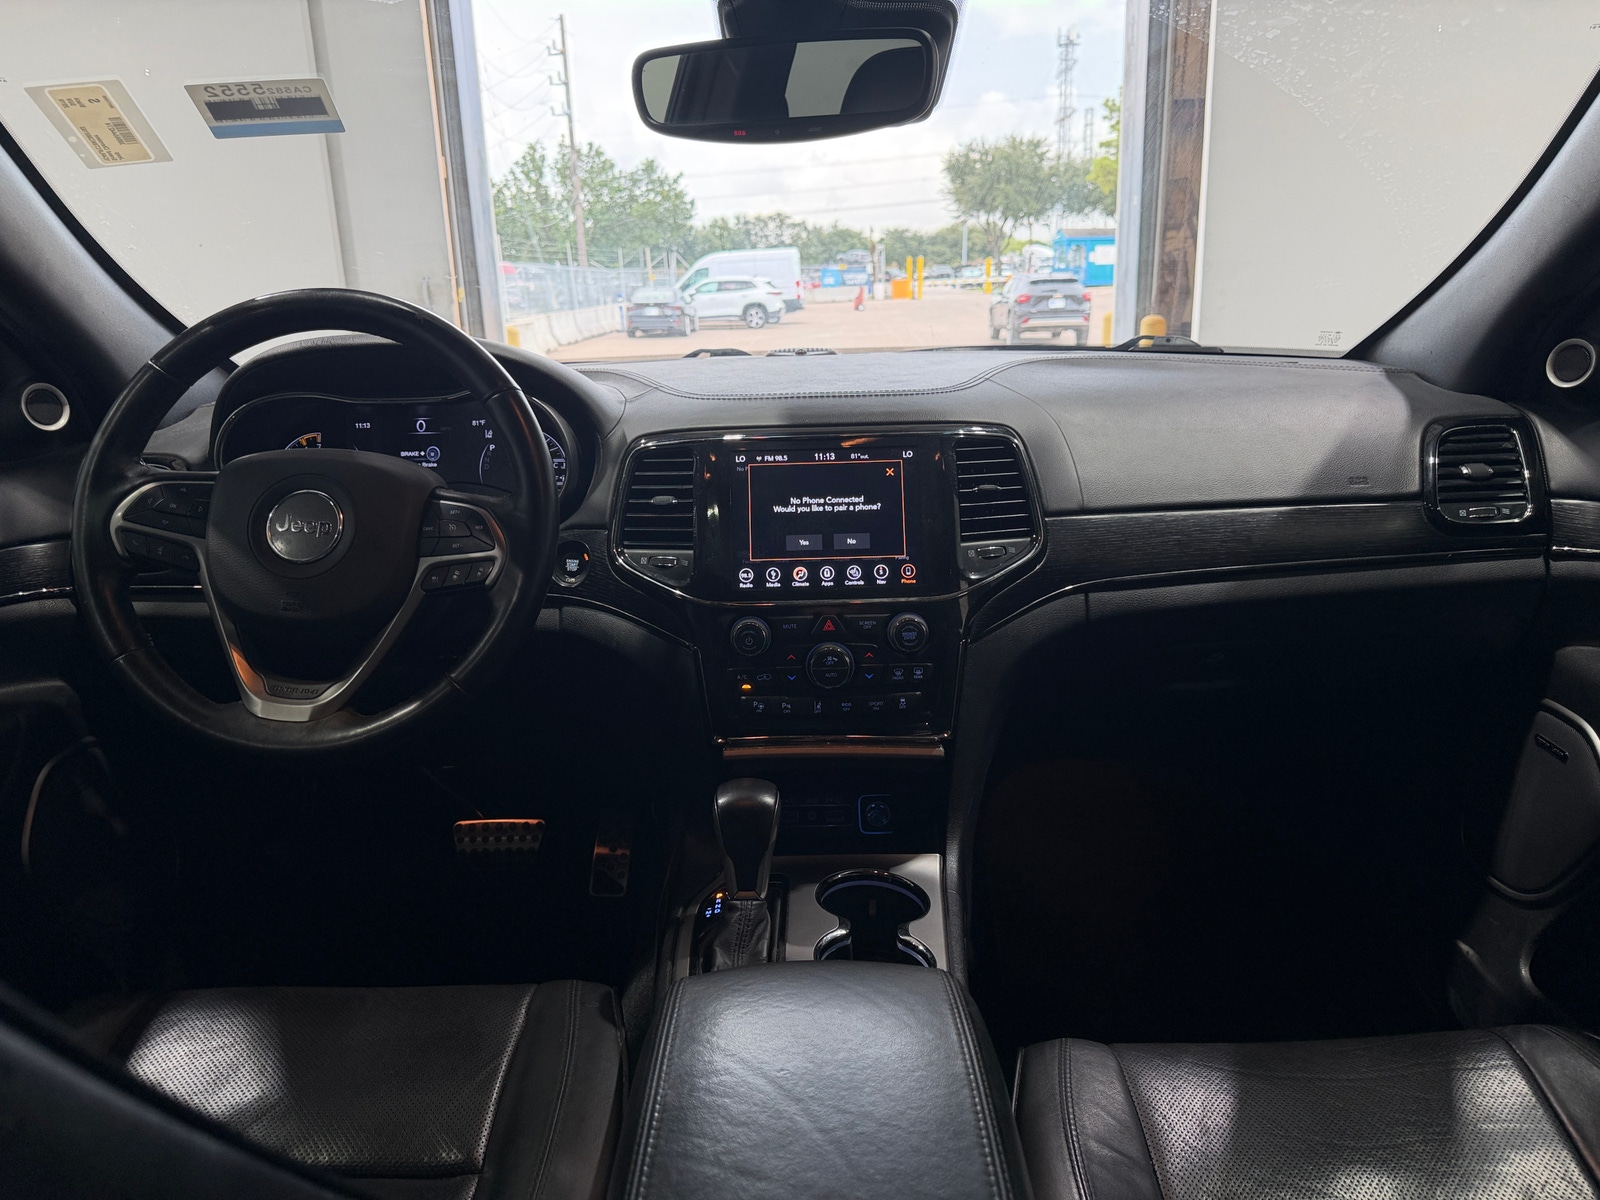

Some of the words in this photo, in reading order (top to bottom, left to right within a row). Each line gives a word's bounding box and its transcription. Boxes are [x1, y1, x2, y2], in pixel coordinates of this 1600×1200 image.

[416, 419, 426, 432] 0
[902, 450, 913, 458] LO
[802, 496, 825, 504] Phone
[826, 495, 864, 504] Connected
[834, 504, 847, 512] pair
[855, 503, 881, 511] phone?
[275, 514, 332, 538] Jeep
